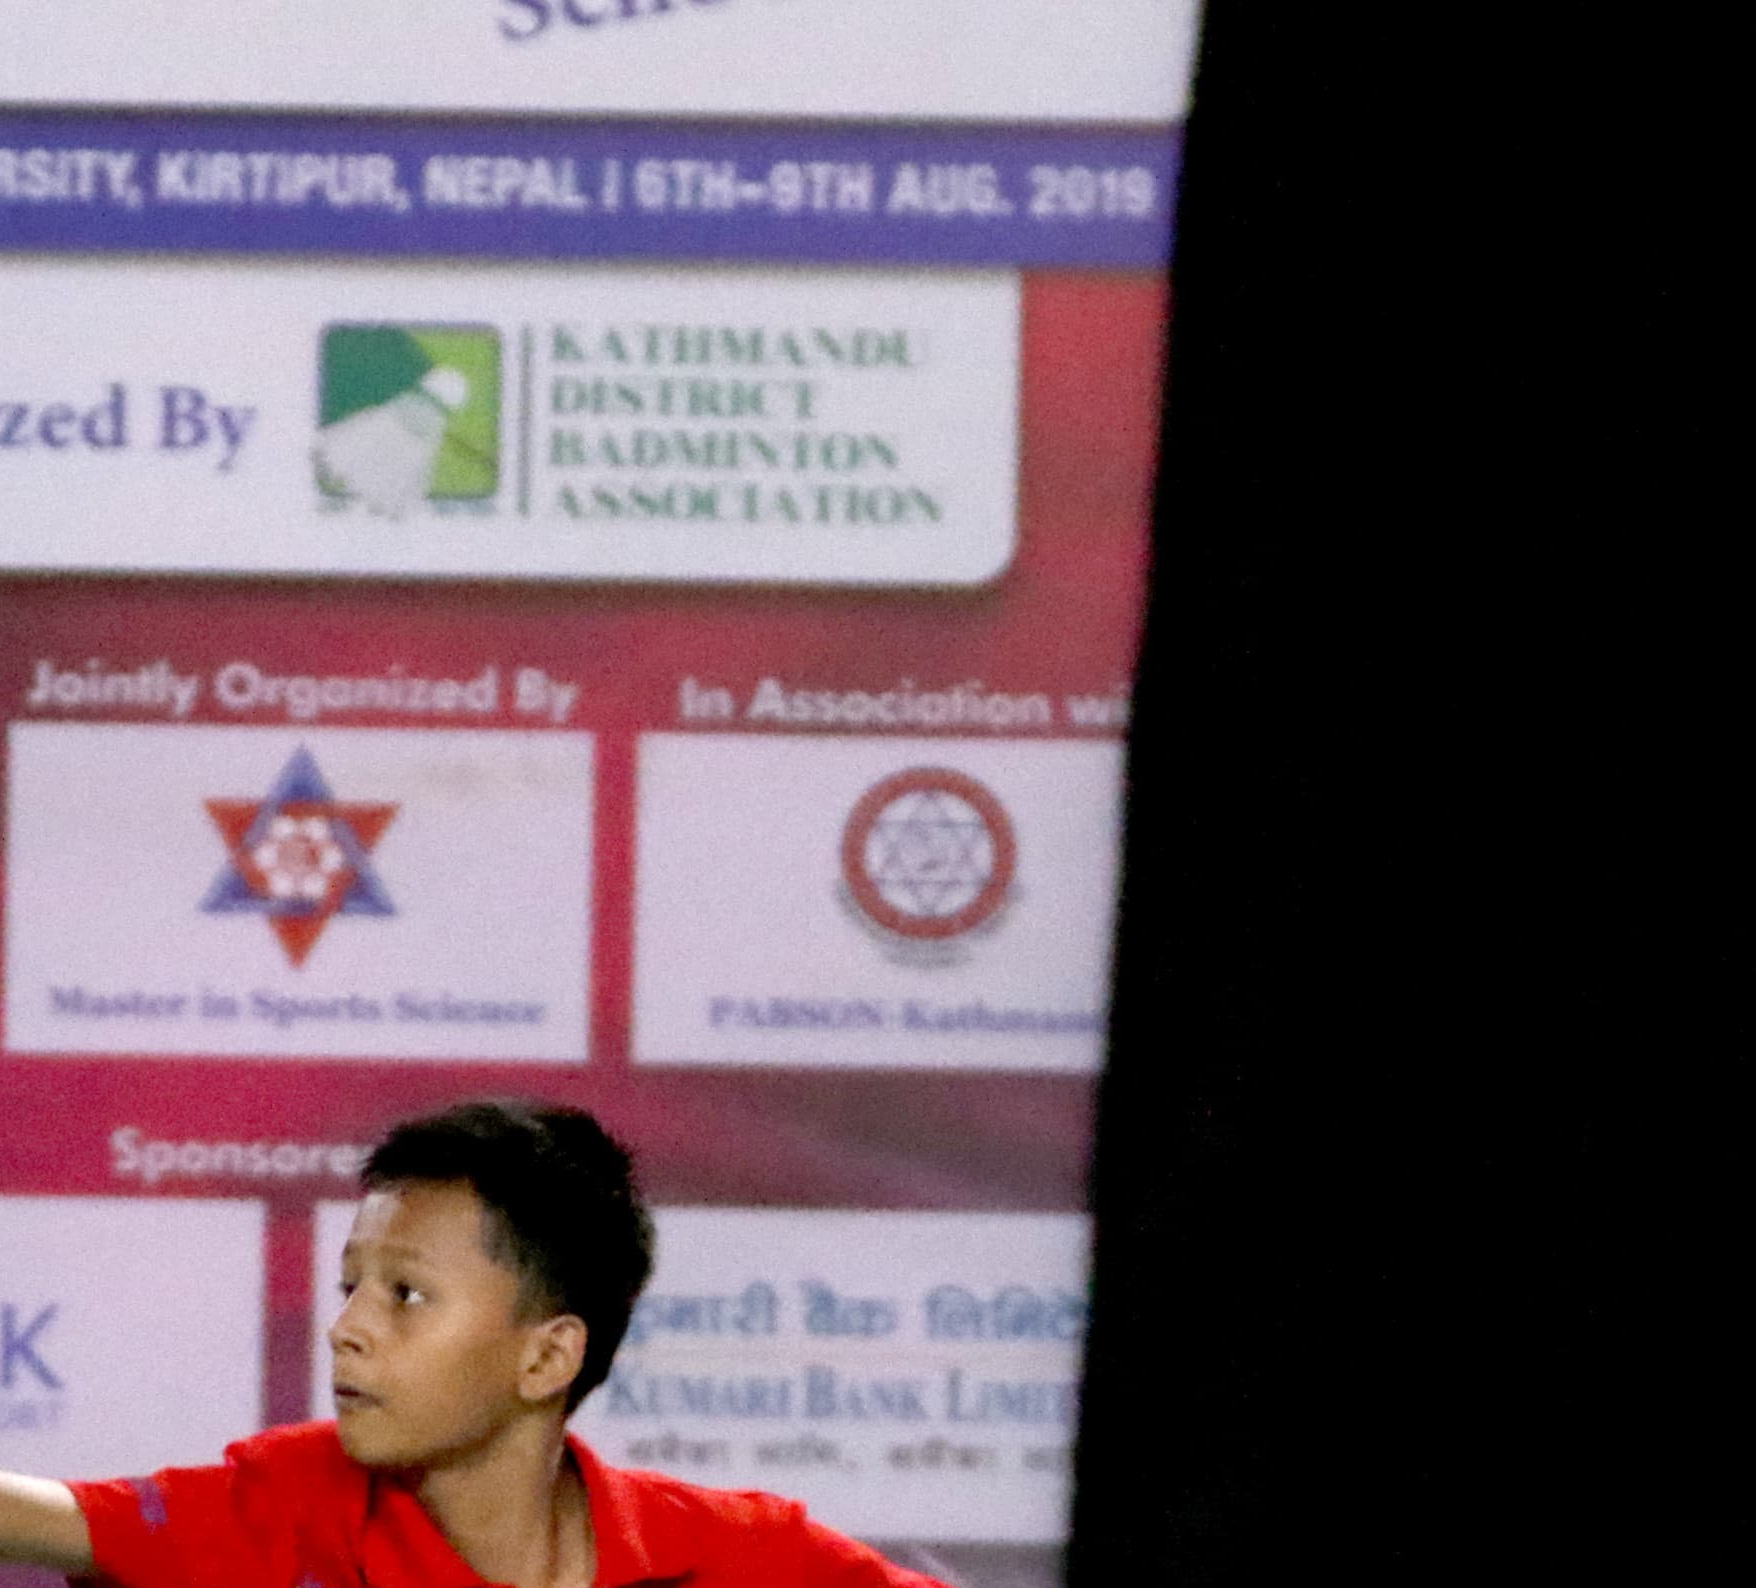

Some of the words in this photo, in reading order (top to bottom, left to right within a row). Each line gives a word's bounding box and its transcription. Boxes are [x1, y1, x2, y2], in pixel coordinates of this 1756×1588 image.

[157, 153, 409, 213] KIRTIPUR,
[425, 155, 585, 211] NEPAL
[889, 163, 1013, 217] AUG.
[1029, 165, 1153, 219] 2019
[550, 324, 932, 368] KATHMANDU
[550, 376, 818, 418] DISTRICT
[159, 381, 255, 473] By
[550, 430, 900, 472] BADMINTON
[552, 482, 946, 524] ASSOCIATION
[27, 657, 199, 715] Jointly
[213, 661, 499, 719] Organized
[515, 667, 579, 723] By
[677, 677, 733, 721] In
[747, 679, 1051, 725] Association
[111, 1127, 375, 1181] Sponsore
